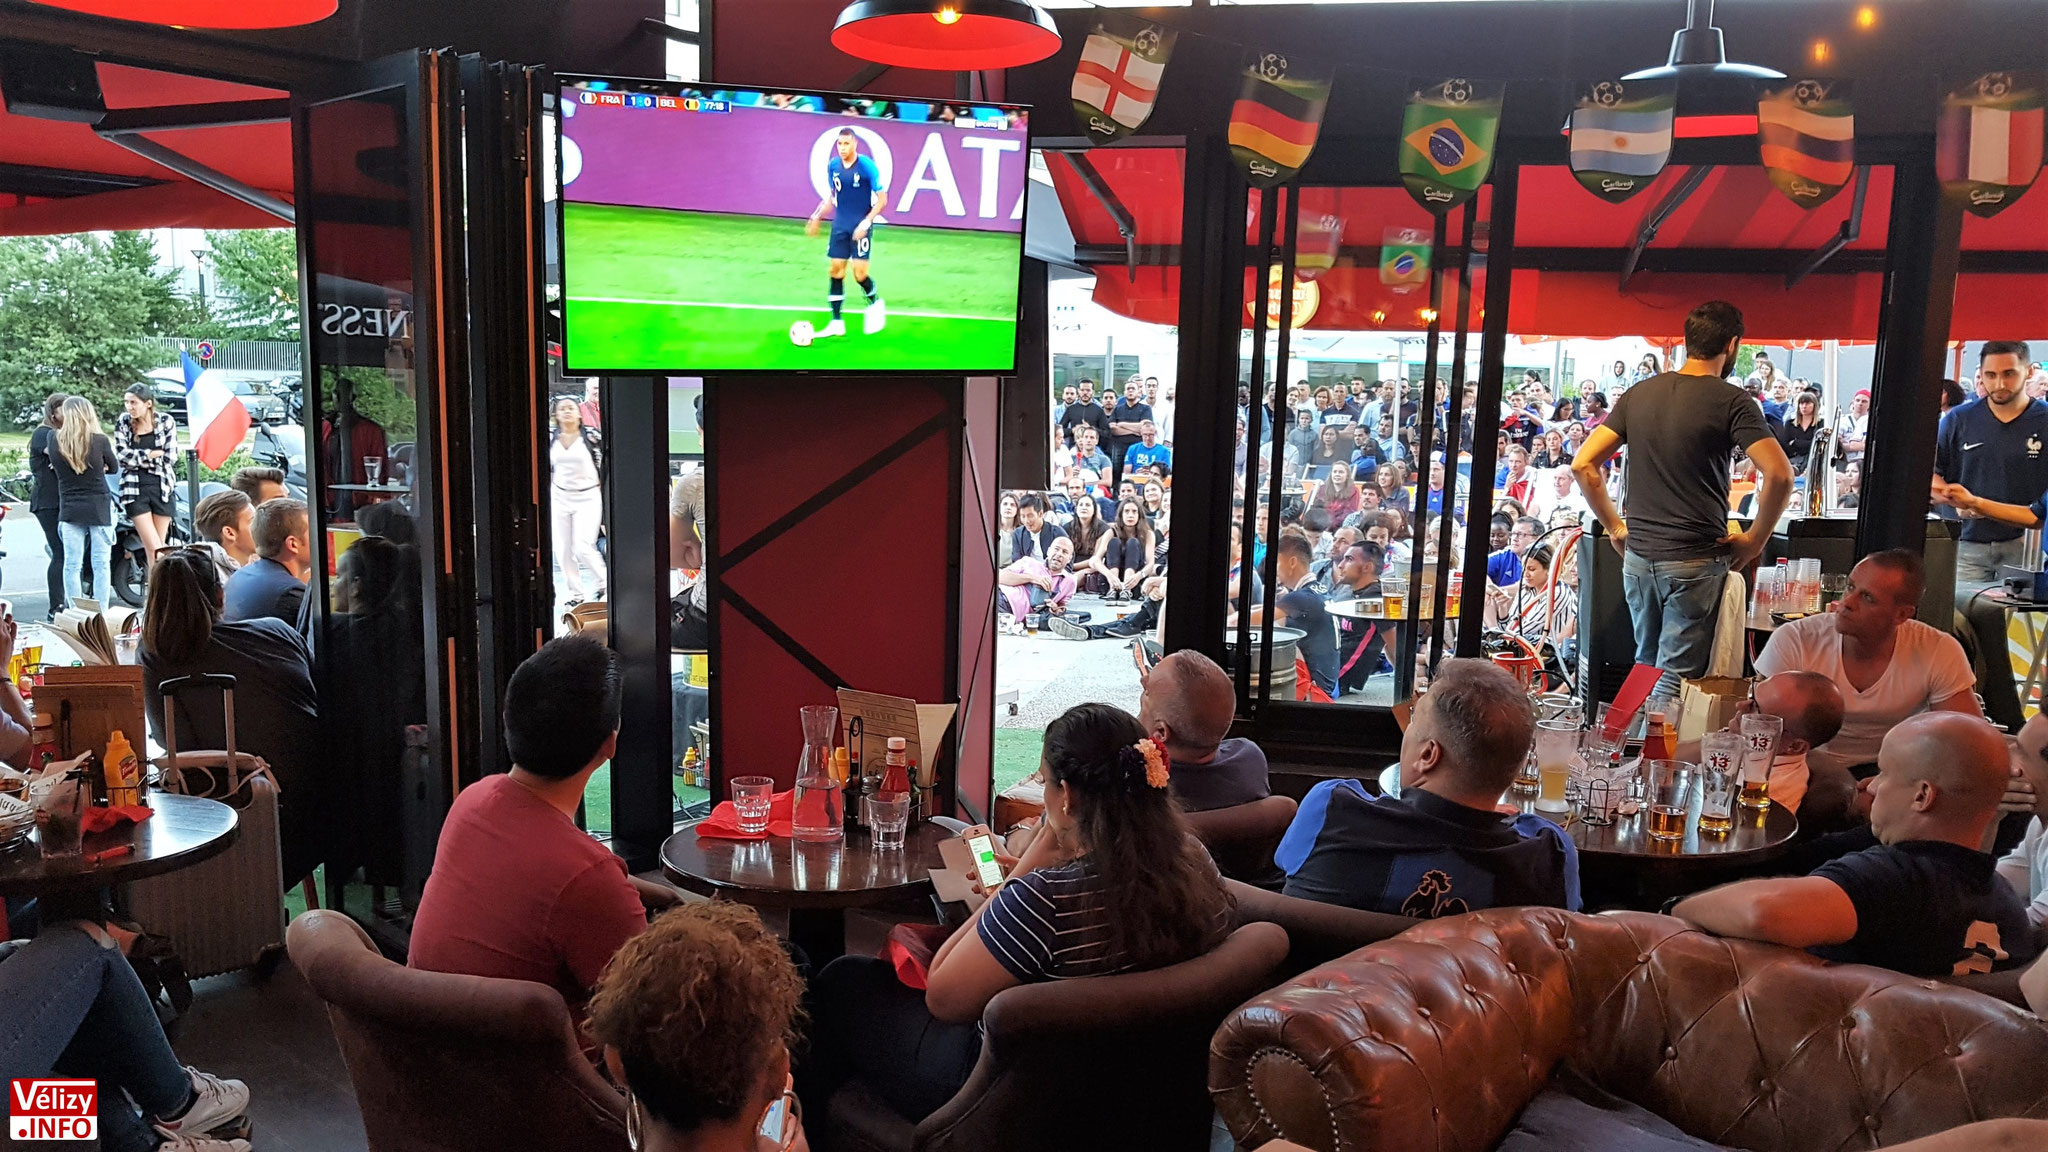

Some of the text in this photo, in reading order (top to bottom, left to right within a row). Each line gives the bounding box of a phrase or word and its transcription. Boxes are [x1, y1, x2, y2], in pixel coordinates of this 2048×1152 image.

[600, 95, 725, 111] FRA 1 0 BEL 77:18
[809, 125, 1025, 224] QAT
[1751, 736, 1769, 748] 13
[1711, 756, 1729, 769] 13
